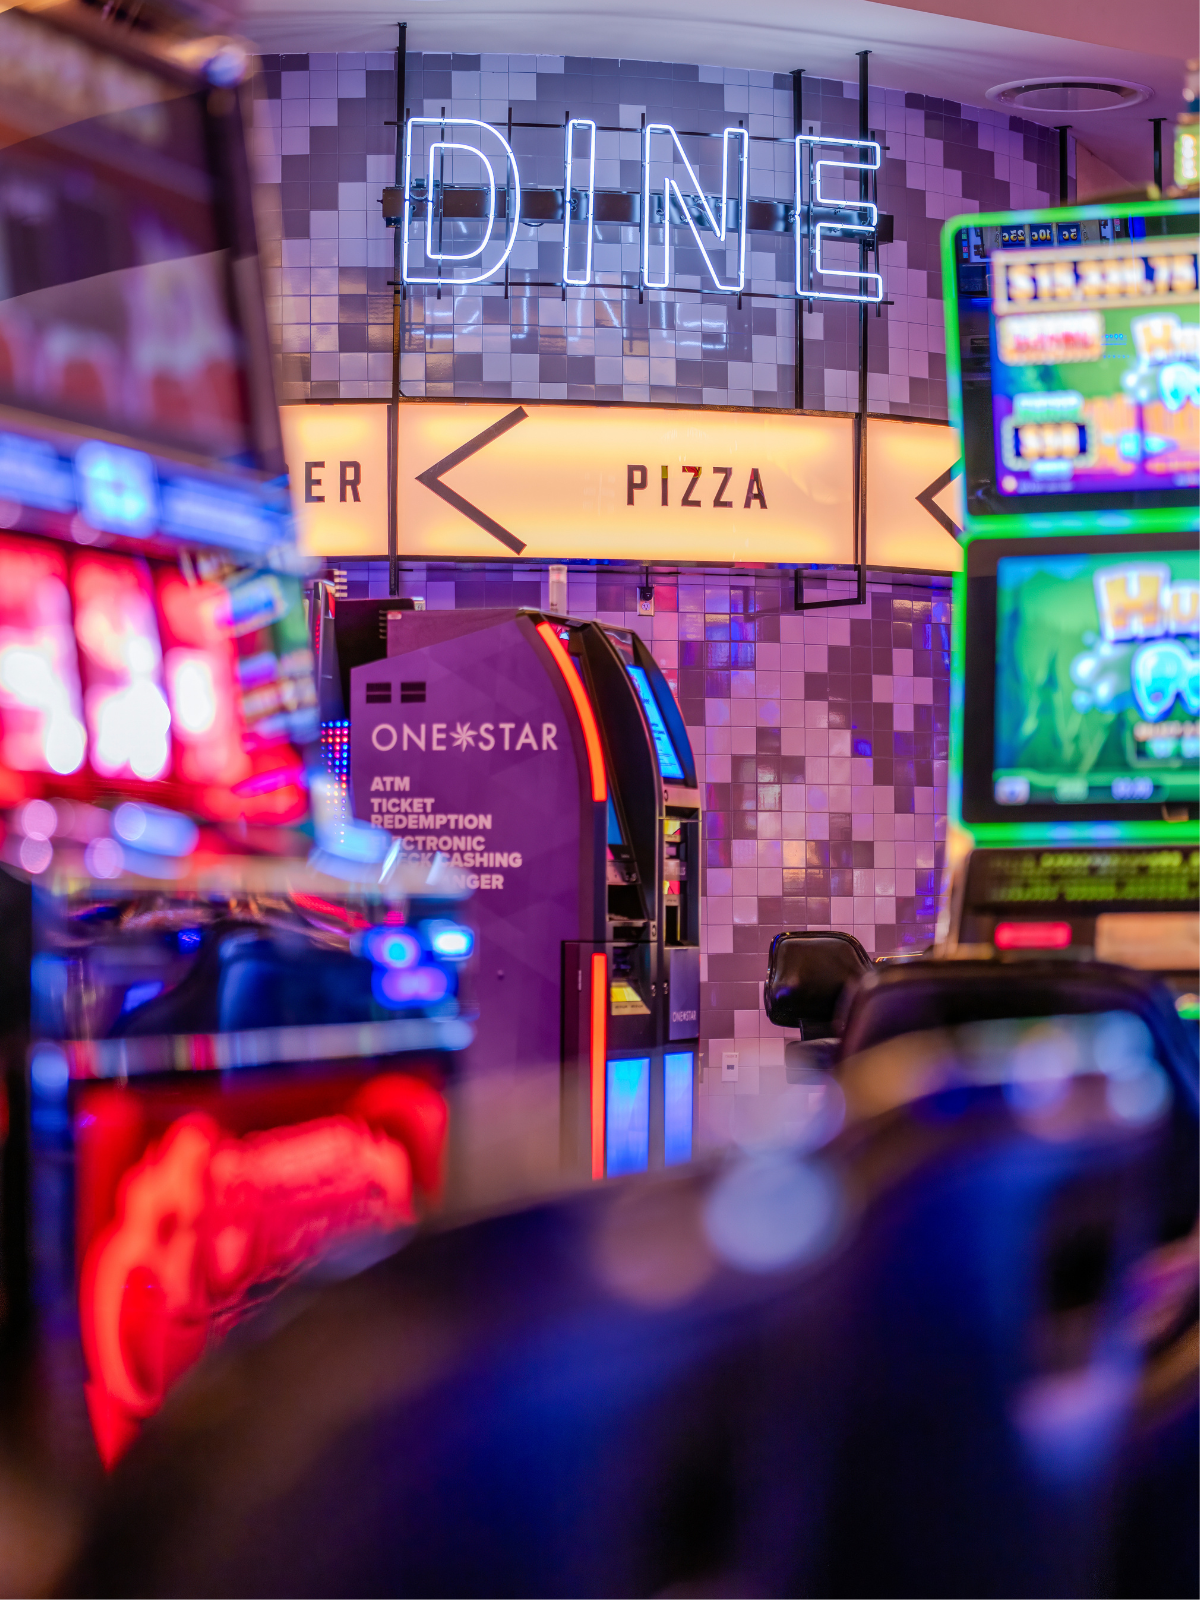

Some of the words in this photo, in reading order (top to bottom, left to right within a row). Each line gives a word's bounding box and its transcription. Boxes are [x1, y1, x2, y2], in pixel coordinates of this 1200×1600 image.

[403, 118, 883, 302] DINE
[304, 460, 361, 504] ER
[626, 464, 768, 510] PIZZA
[370, 776, 411, 792] ATM
[370, 798, 435, 813] TICKET
[370, 814, 492, 830] REDEMPTION
[440, 851, 523, 868] CASHING
